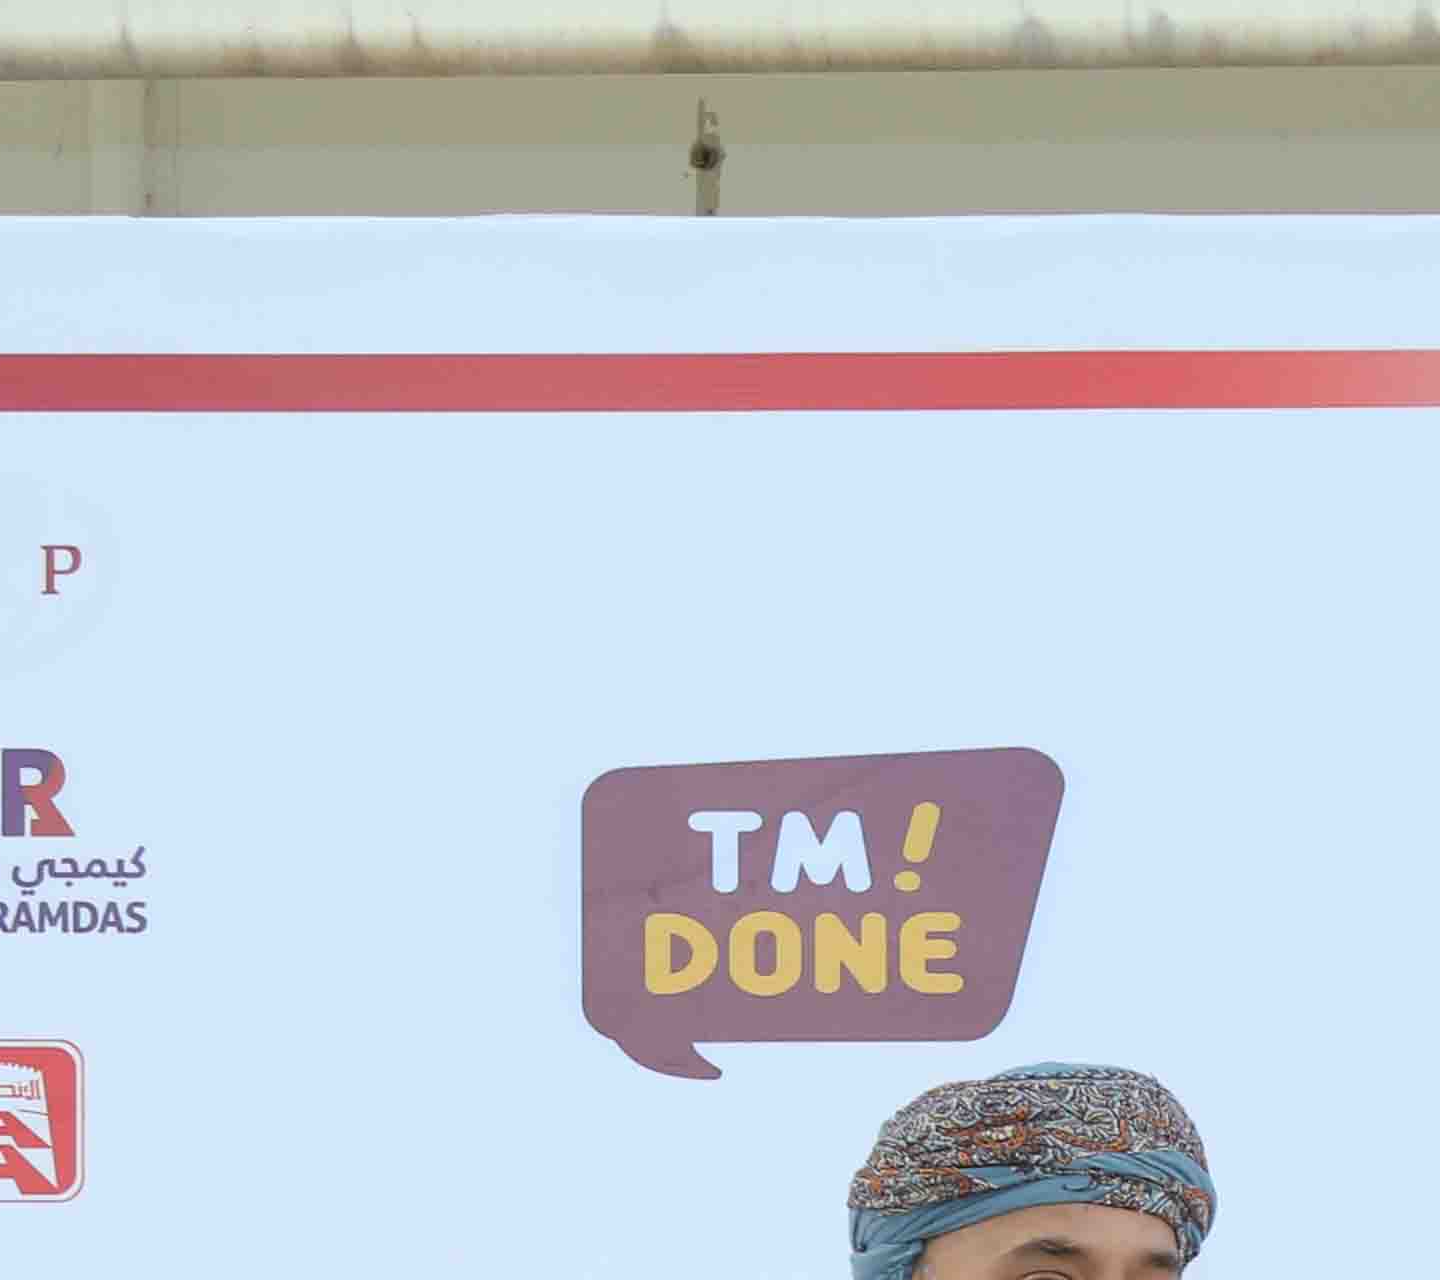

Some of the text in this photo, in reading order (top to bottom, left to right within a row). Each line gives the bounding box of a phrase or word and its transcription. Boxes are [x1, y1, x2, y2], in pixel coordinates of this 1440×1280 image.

[40, 545, 82, 594] P
[12, 846, 147, 895] كيمجي
[644, 911, 964, 996] DONE
